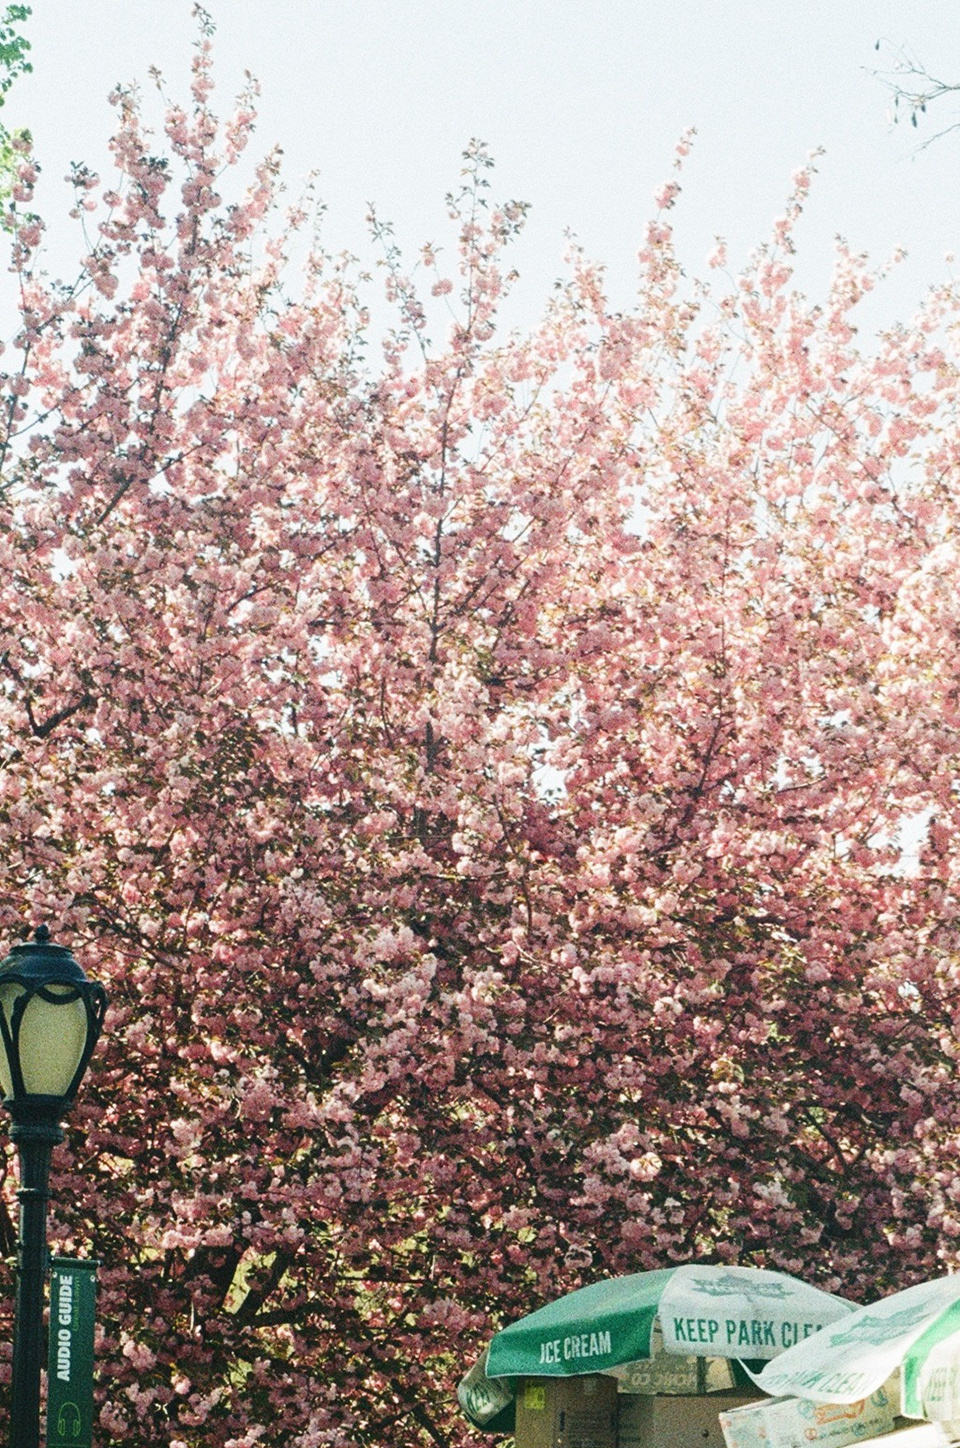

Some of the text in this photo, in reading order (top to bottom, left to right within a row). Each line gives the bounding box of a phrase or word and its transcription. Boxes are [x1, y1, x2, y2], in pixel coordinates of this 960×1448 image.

[57, 1274, 73, 1381] AUDIO GUIDE
[674, 1317, 719, 1344] KEEP
[726, 1319, 775, 1347] PARK
[540, 1331, 612, 1365] ICE CREAM
